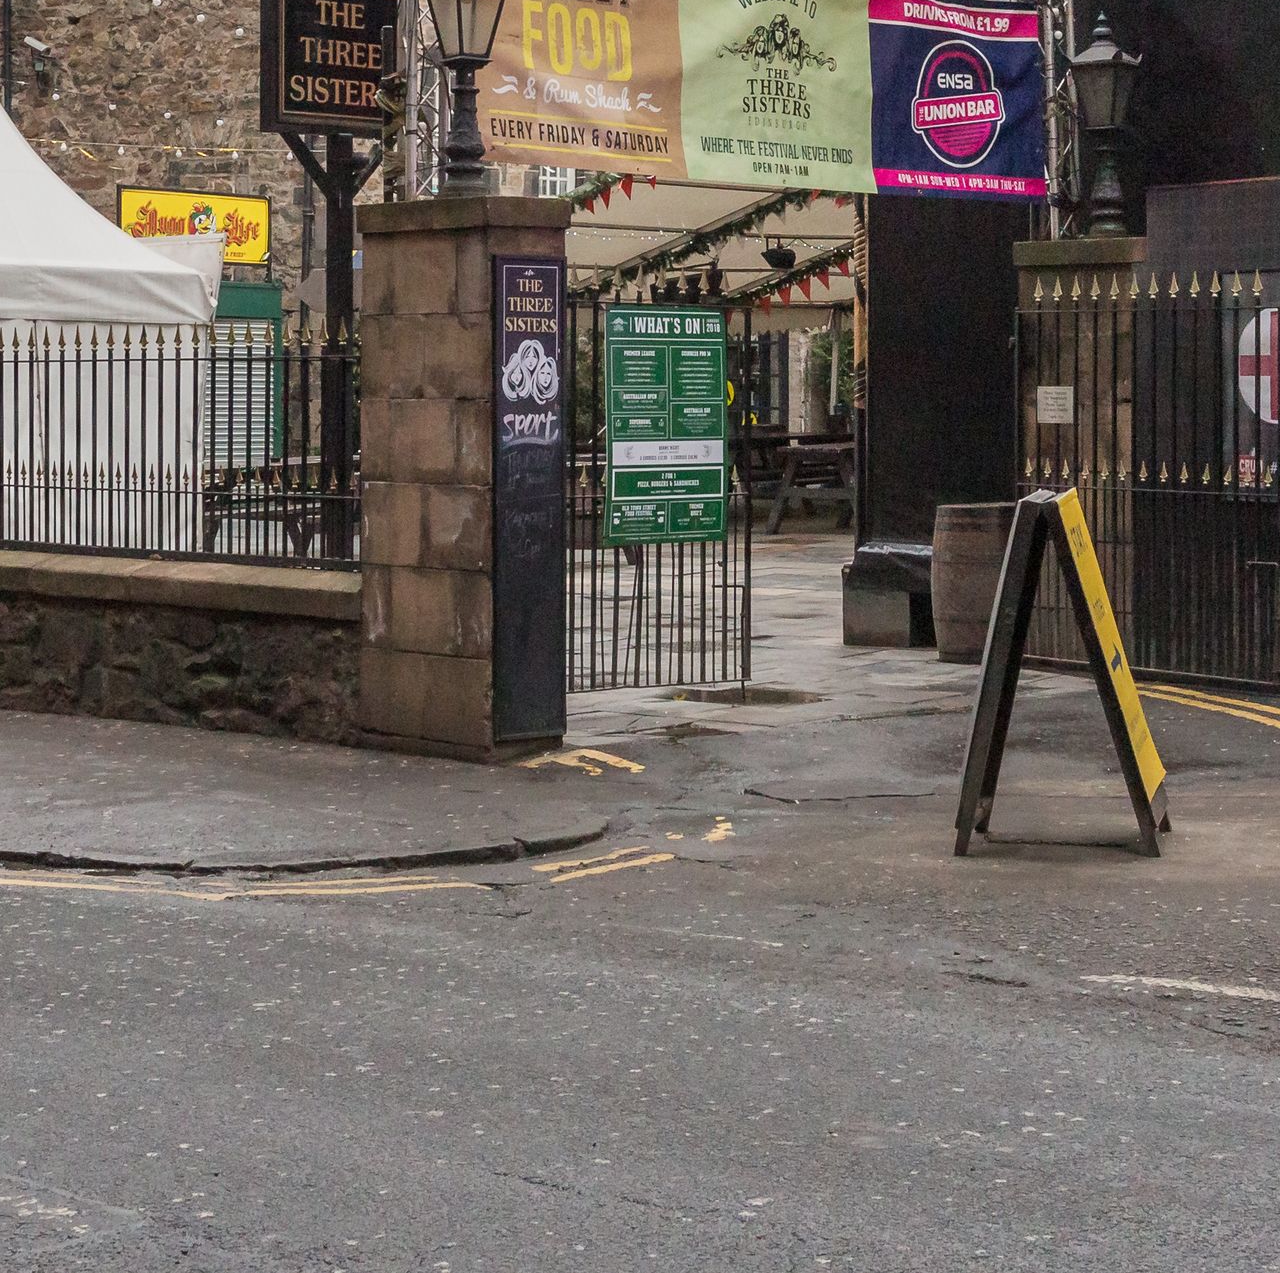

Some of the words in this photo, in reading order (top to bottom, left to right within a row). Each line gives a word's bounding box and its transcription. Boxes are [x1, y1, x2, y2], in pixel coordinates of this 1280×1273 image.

[315, 0, 365, 30] THE
[903, 2, 948, 24] DRINKS
[948, 11, 976, 30] FROM
[976, 16, 1010, 33] £1.99
[299, 36, 383, 70] THREE
[766, 67, 789, 80] THE
[289, 74, 382, 109] SISTER
[523, 77, 536, 100] &
[543, 79, 582, 105] Rum
[585, 84, 632, 112] Shack
[747, 78, 807, 101] THREE
[742, 96, 811, 120] SISTERS
[924, 102, 967, 122] UNION
[968, 99, 996, 117] BAR
[490, 118, 533, 141] EVERY
[539, 123, 585, 146] FRIDAY
[591, 128, 600, 147] &
[605, 129, 669, 155] SATURDAY
[700, 136, 734, 154] WHERE
[737, 139, 756, 156] THE
[758, 141, 800, 160] FESTIVAL
[801, 145, 829, 162] NEVER
[831, 147, 853, 165] ENDS
[752, 161, 772, 173] OPEN
[1001, 179, 1025, 192] THU-SAT
[516, 278, 544, 293] THE
[507, 297, 554, 313] THREE
[505, 317, 558, 334] SISTERS
[634, 317, 681, 335] WHAT'S
[685, 318, 700, 335] ON
[706, 323, 721, 333] 2018
